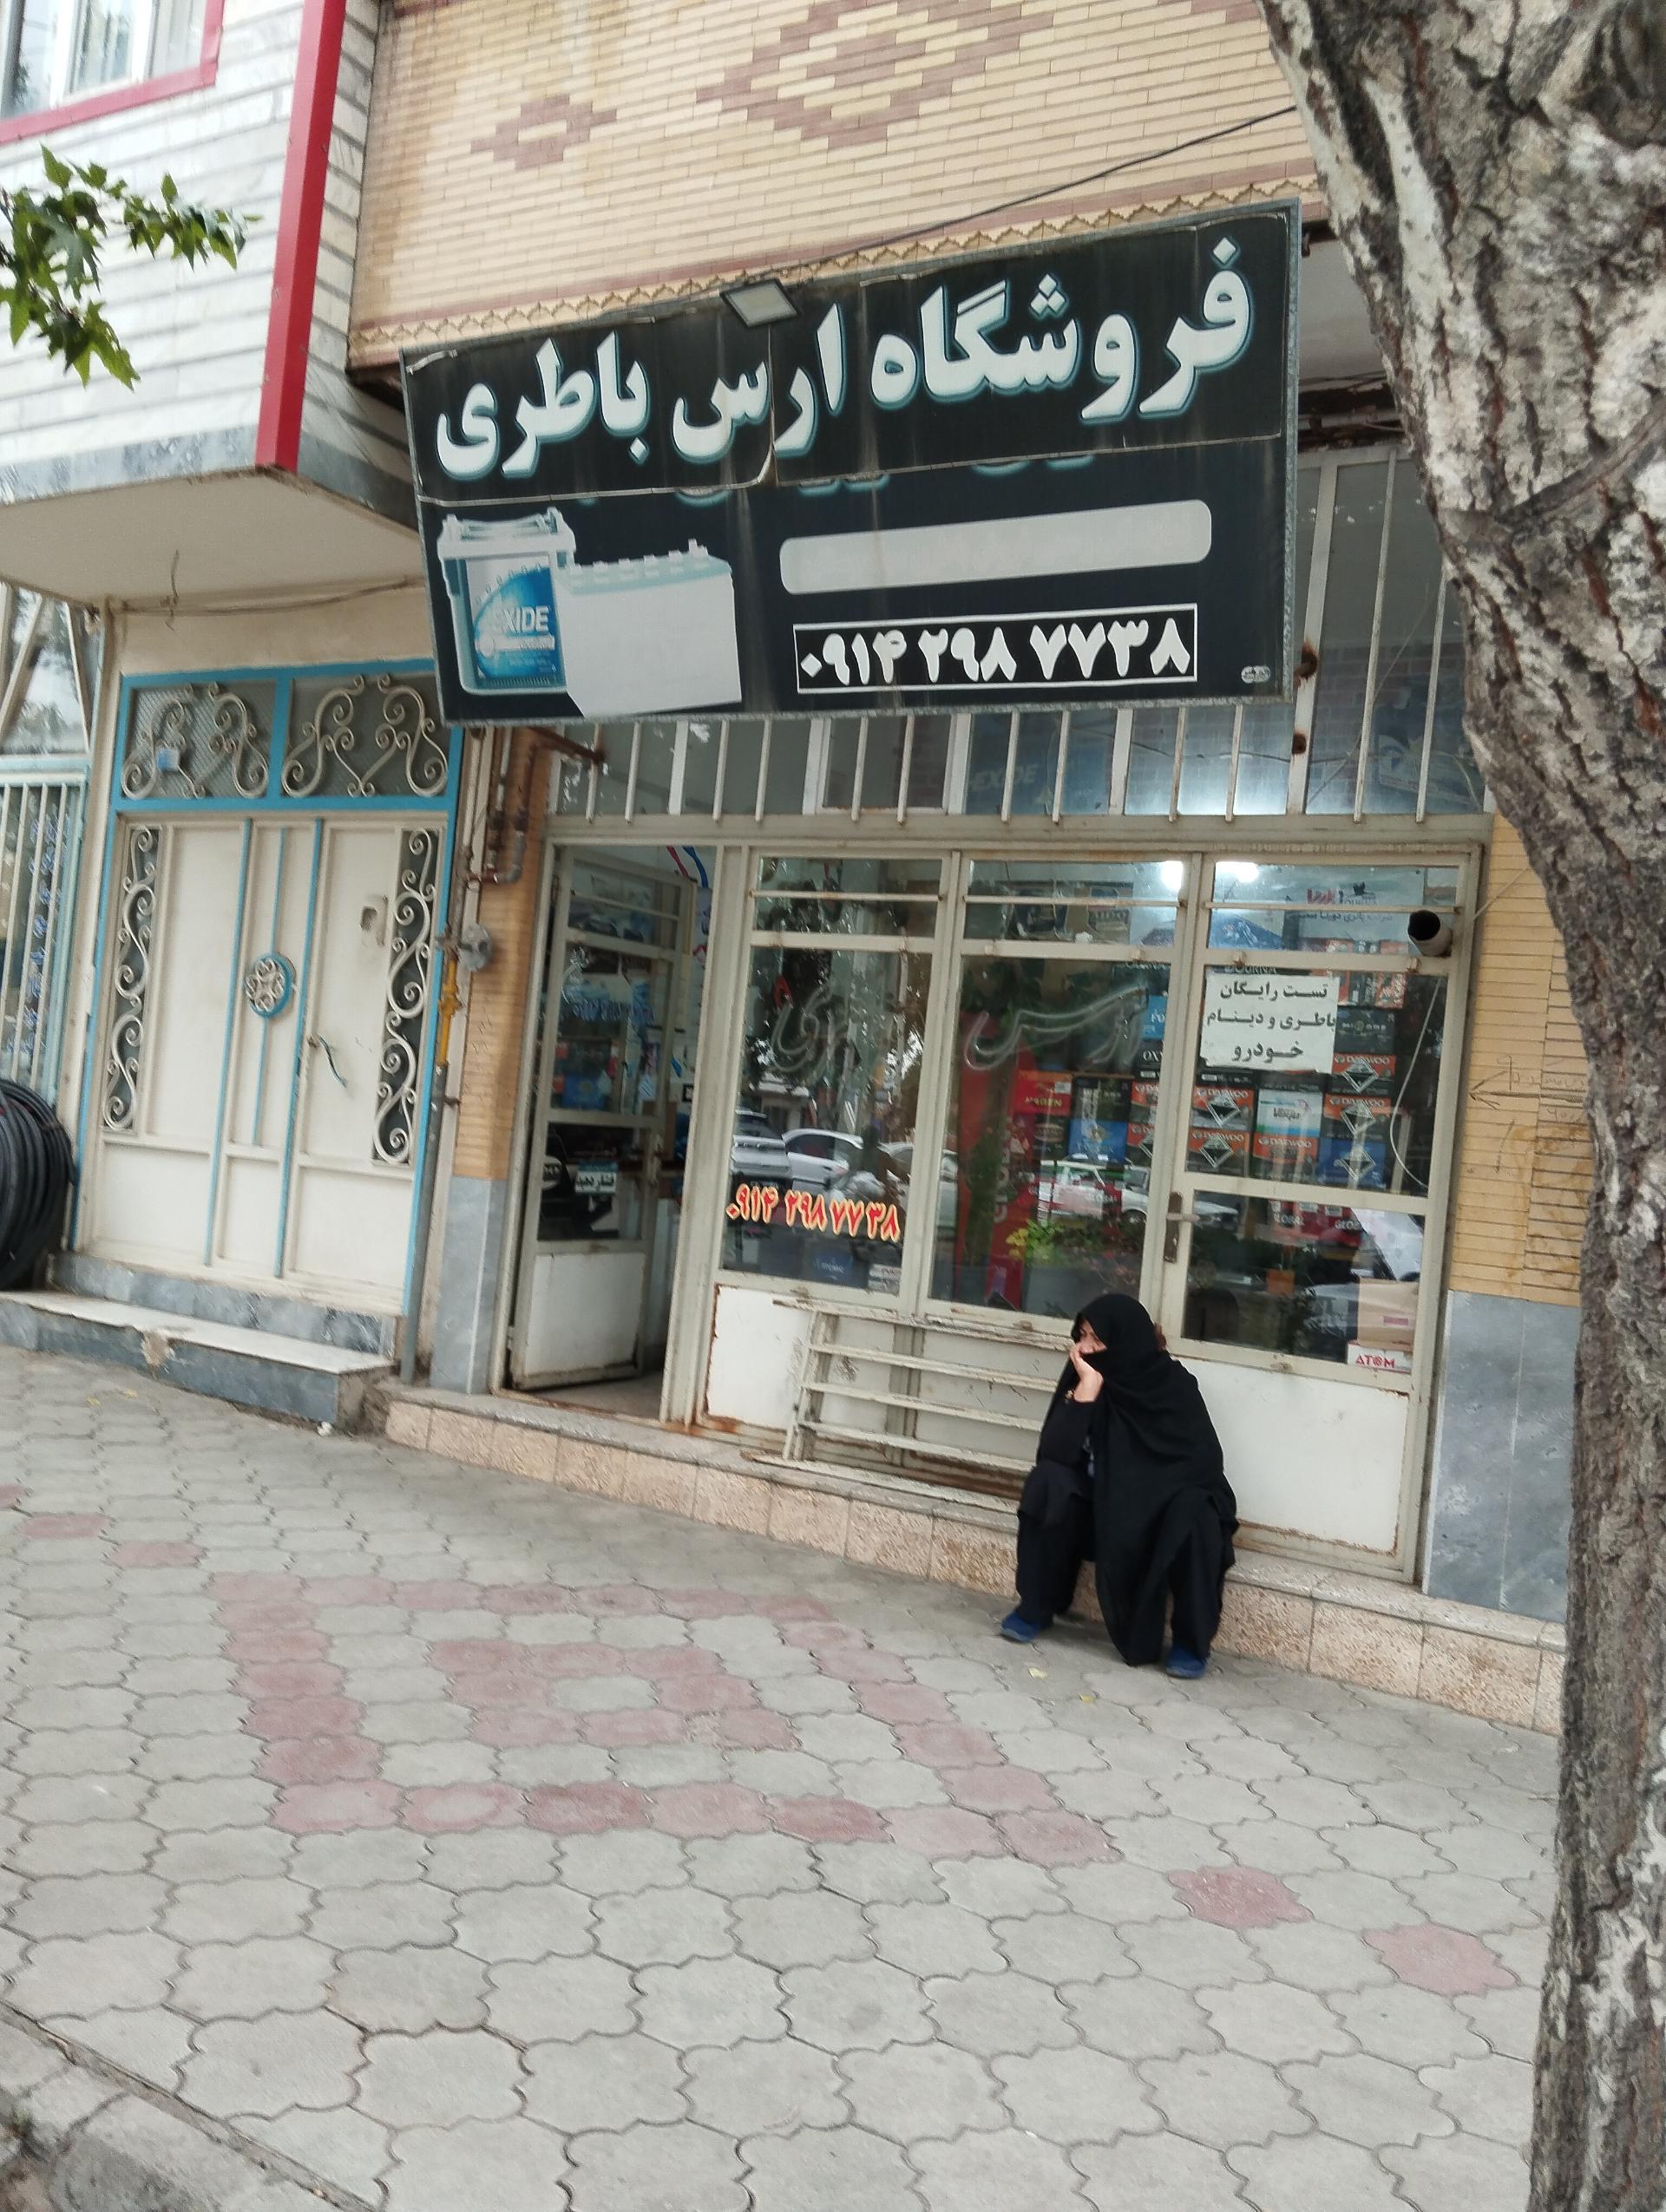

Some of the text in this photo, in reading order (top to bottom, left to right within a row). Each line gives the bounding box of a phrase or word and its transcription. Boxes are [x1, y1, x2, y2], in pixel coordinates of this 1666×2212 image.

[436, 238, 1255, 480] فروشگاه ارس باطری
[495, 605, 550, 634] XIDE
[800, 617, 1191, 686] ۰۹۱۴ ۲۹۸ ۷۷۳۸
[1283, 984, 1328, 998] تست
[1207, 1007, 1263, 1027] دینام
[1267, 1018, 1276, 1030] و
[1279, 1011, 1336, 1032] باطری
[1231, 1041, 1304, 1063] خودرو
[725, 1183, 779, 1225] ۰۹۱۴
[1355, 1353, 1395, 1369] ATOM
